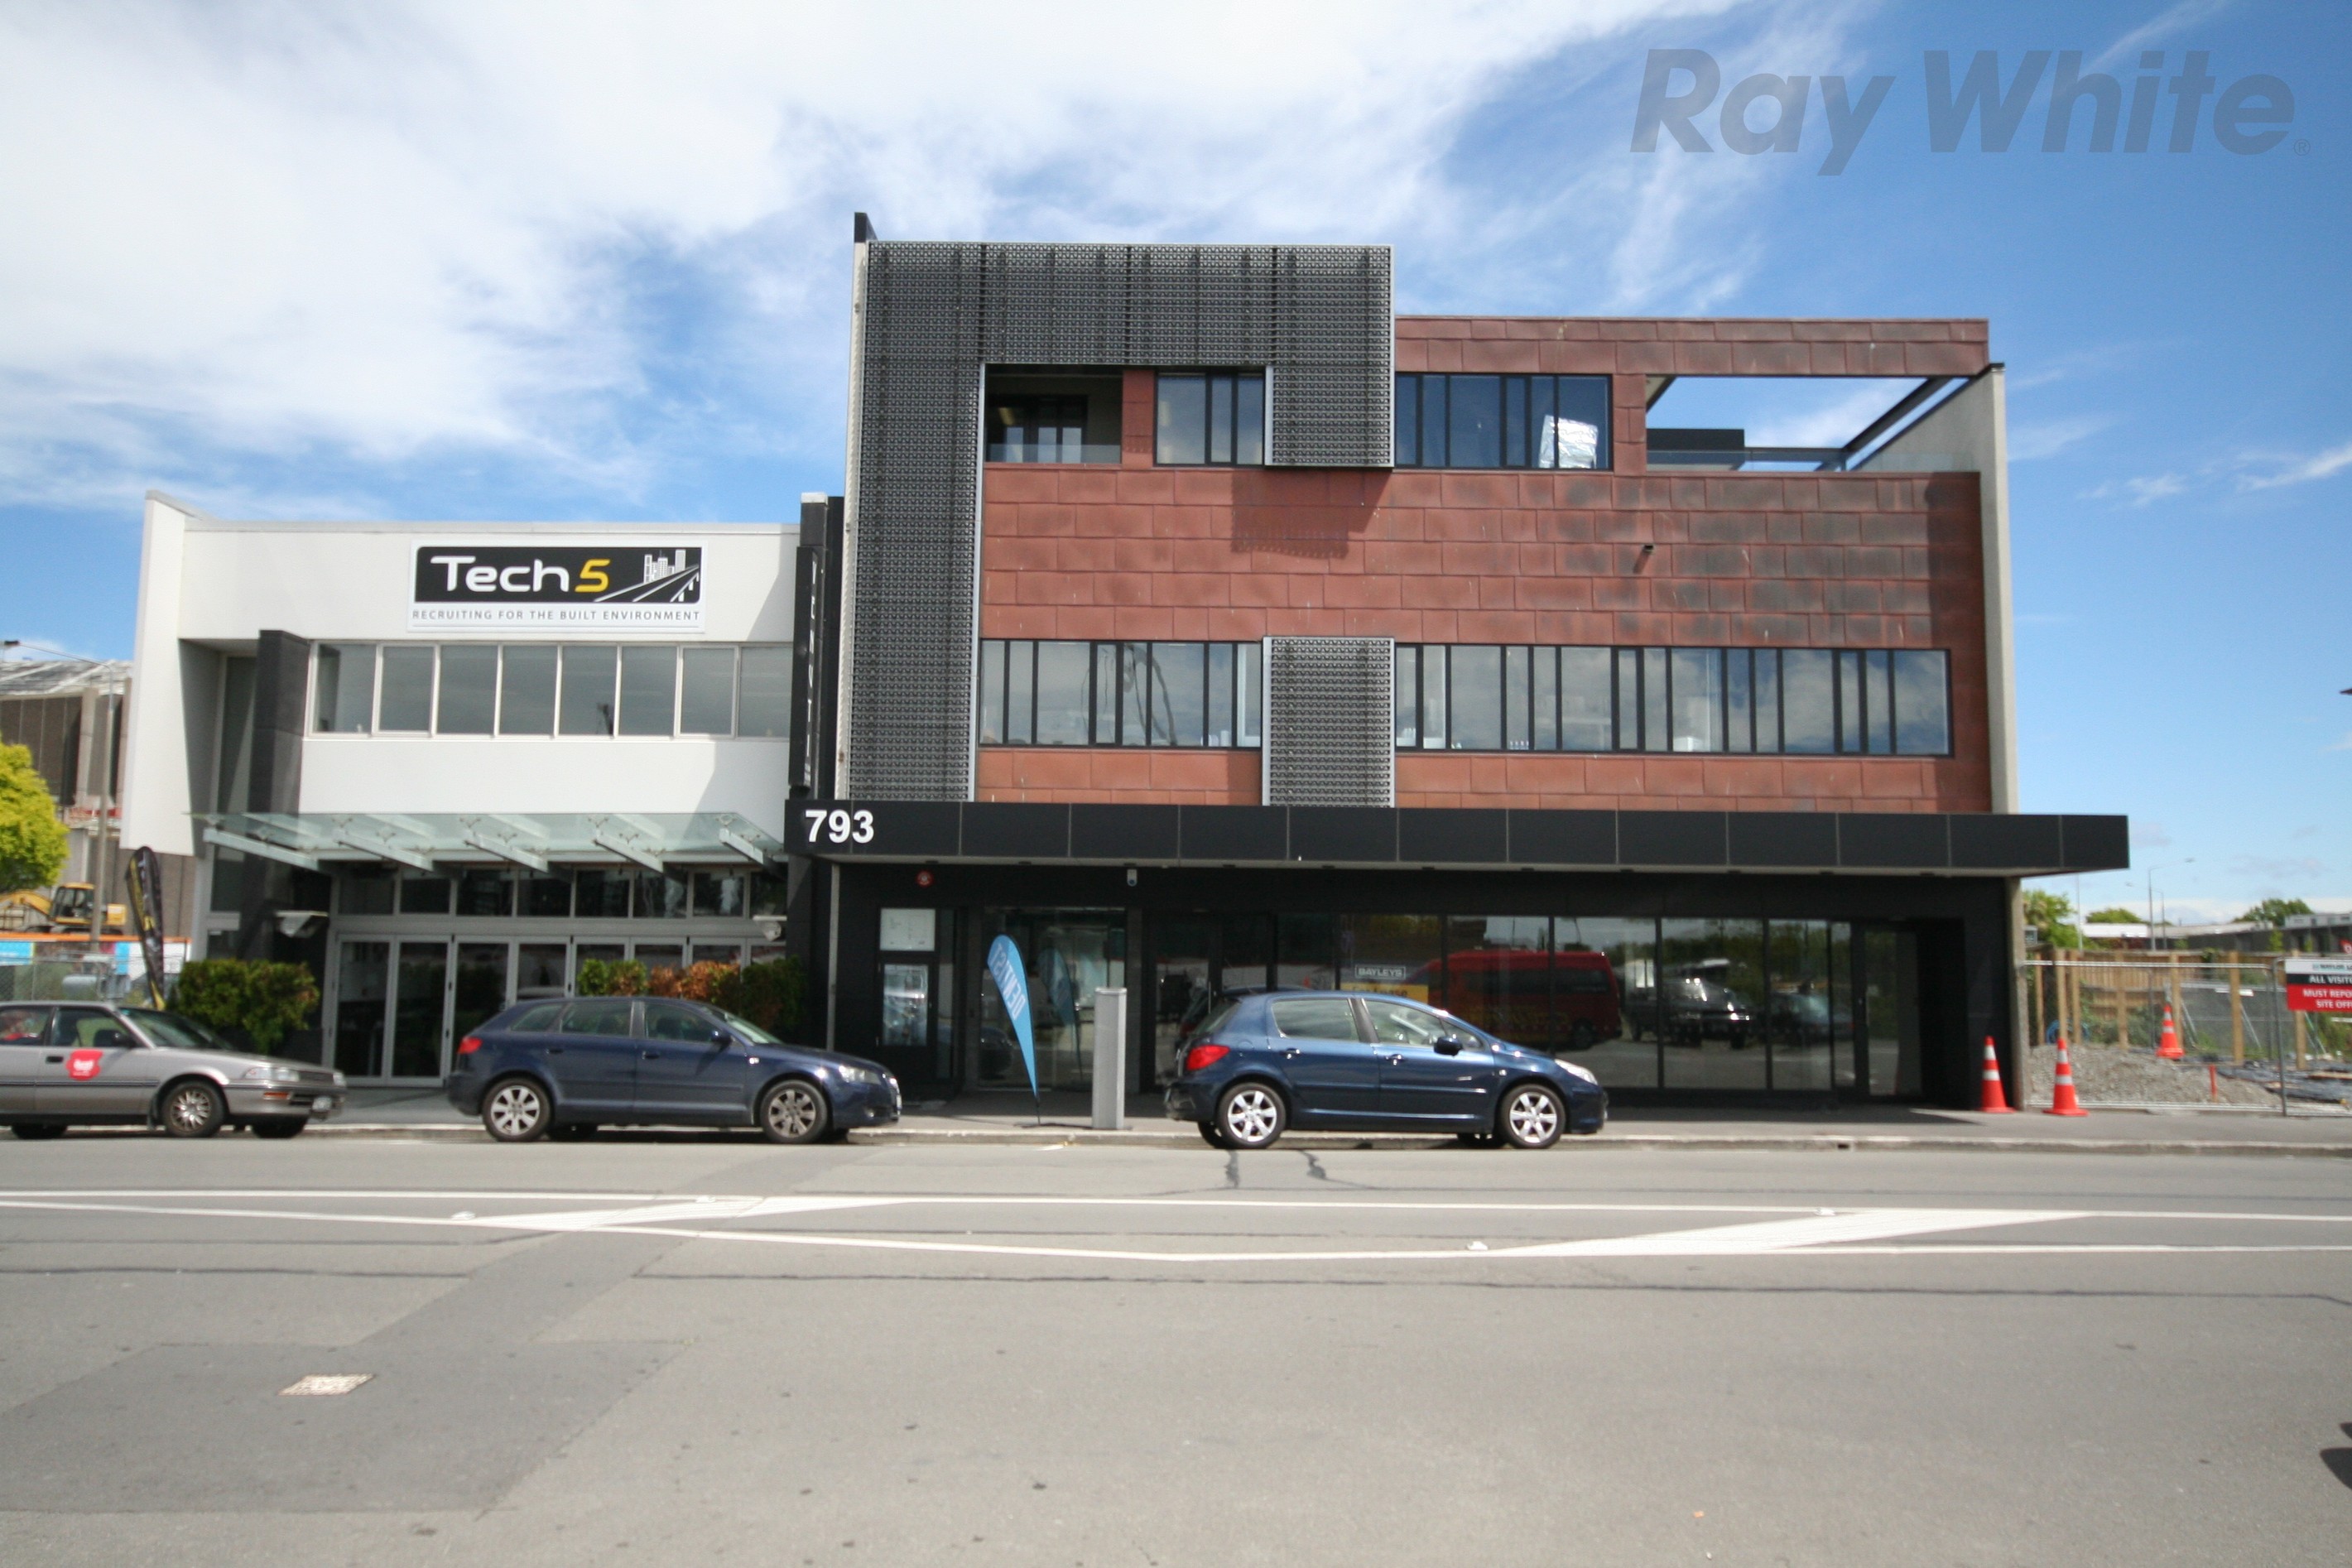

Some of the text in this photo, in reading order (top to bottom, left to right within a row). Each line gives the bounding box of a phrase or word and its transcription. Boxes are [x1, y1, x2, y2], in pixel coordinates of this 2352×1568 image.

[412, 609, 700, 621] RECRUITING FOR THE BUILT ENVIRONMENT
[806, 809, 874, 844] 793
[1359, 968, 1402, 977] BAYLEYS
[2309, 975, 2326, 984] ALL
[2303, 988, 2328, 998] MUST
[2316, 999, 2334, 1008] SITE
